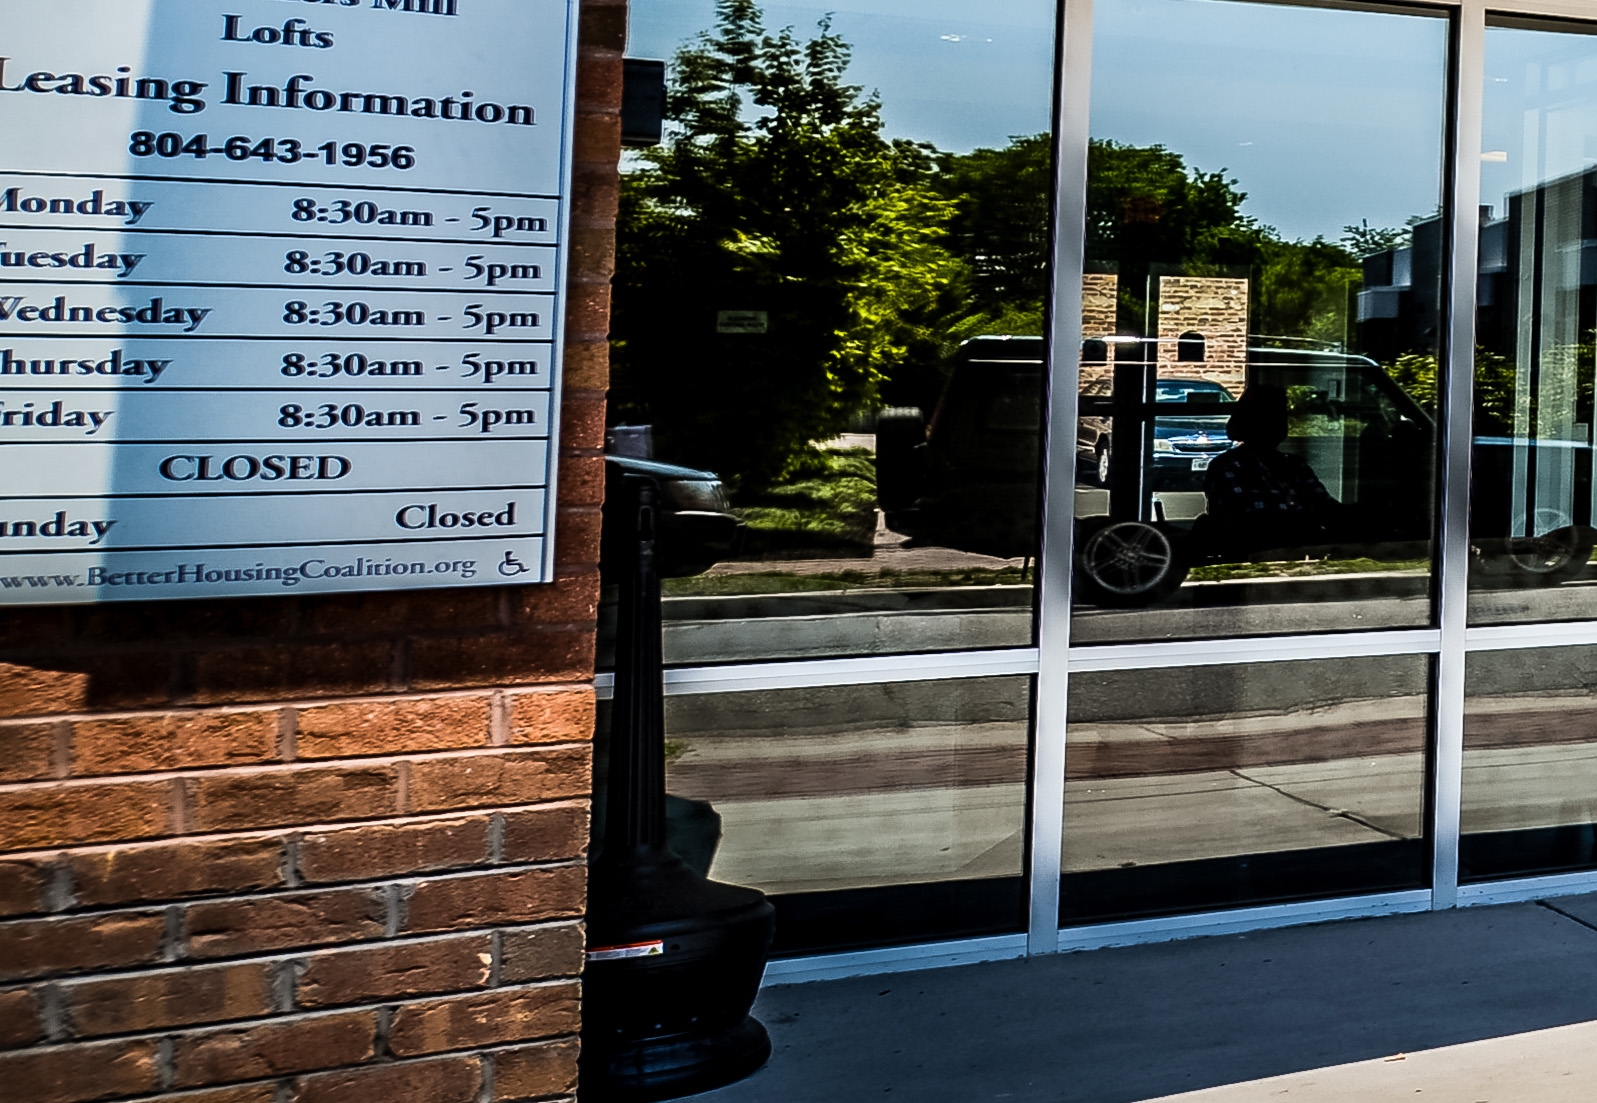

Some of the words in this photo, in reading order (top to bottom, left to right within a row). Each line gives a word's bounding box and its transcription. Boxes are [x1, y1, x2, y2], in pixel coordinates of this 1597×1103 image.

[221, 15, 334, 49] Lofts
[0, 57, 208, 113] Leasing
[220, 71, 537, 126] Information
[129, 131, 415, 170] 804-643-1956
[291, 198, 434, 227] 8:30am
[471, 207, 548, 237] 5pm
[0, 242, 147, 277] uesday
[284, 251, 428, 279] 8:30am
[463, 256, 542, 287] 5pm
[282, 300, 426, 327] 8:30am
[462, 305, 540, 335] 5pm
[0, 349, 173, 384] hursday
[280, 353, 424, 378] 8:30am
[460, 353, 538, 384] 5pm
[0, 400, 115, 435] riday
[277, 404, 421, 429] 8:30am
[457, 404, 535, 433] 5pm
[158, 454, 352, 482] CLOSED
[395, 502, 516, 531] Closed
[0, 557, 477, 589] www.BetterHousingCoalition.org
